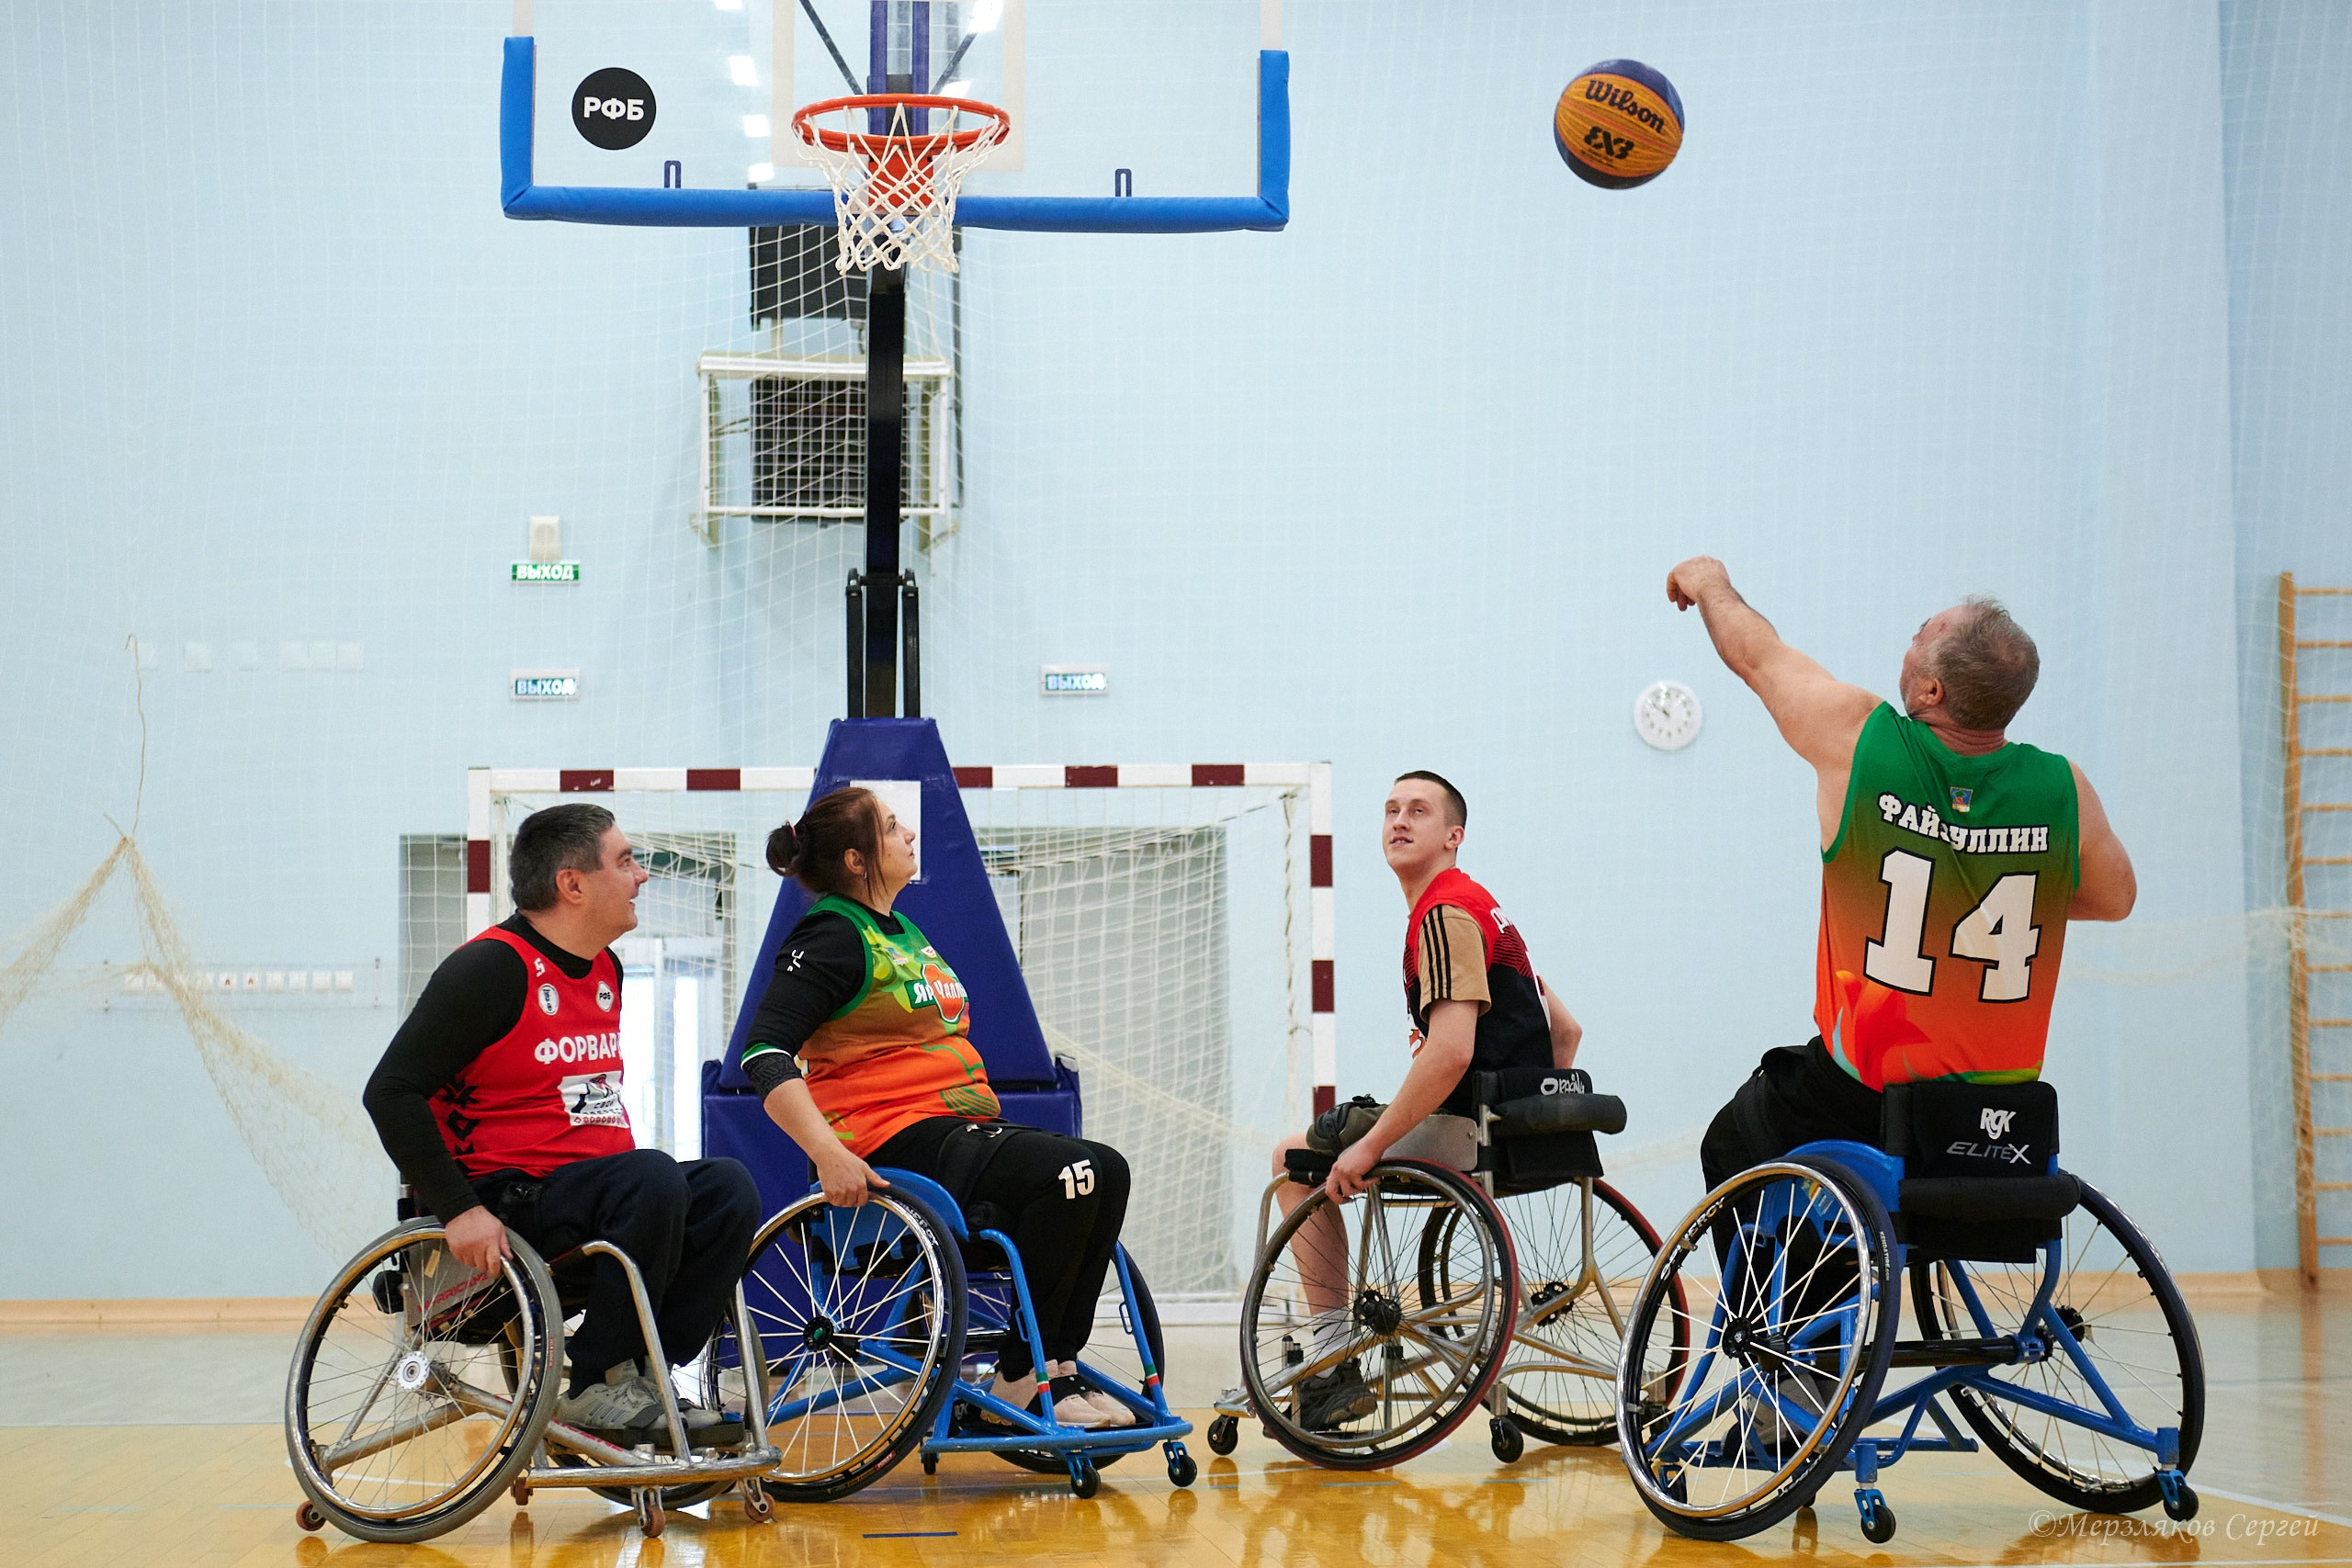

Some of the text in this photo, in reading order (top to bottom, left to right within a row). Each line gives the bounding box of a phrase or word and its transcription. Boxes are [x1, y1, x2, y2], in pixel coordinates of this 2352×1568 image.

[583, 96, 645, 121] РФБ
[1585, 79, 1666, 134] Wilson
[516, 564, 574, 581] ВЫХОД
[1863, 847, 2042, 1003] 14
[534, 957, 546, 977] 5
[913, 982, 935, 1004] ЯР
[1946, 1141, 2031, 1165] ELITEX
[1057, 1158, 1095, 1200] 15
